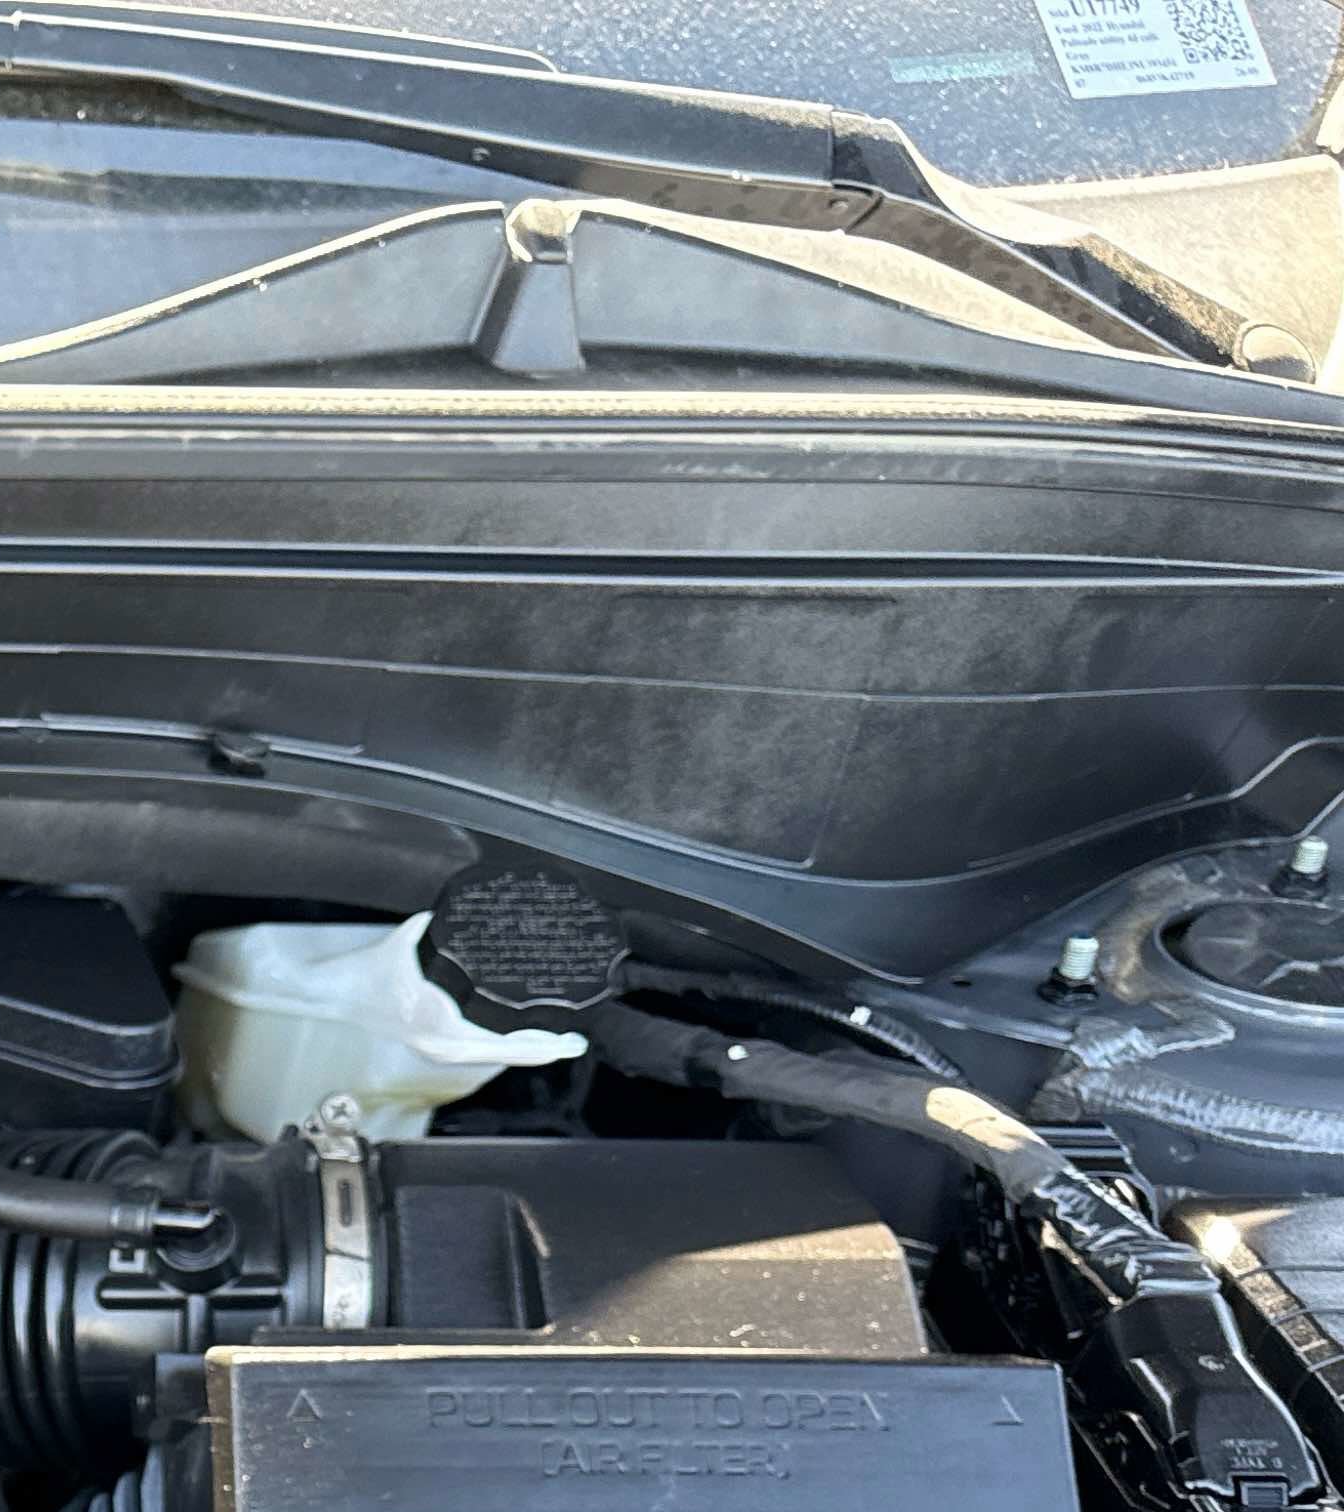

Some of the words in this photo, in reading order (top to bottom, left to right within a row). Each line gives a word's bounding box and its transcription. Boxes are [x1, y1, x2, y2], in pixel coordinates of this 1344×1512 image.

[425, 1387, 557, 1428] PULL
[567, 1387, 668, 1428] OUT
[677, 1387, 744, 1429] TO
[760, 1388, 892, 1431] OPEN
